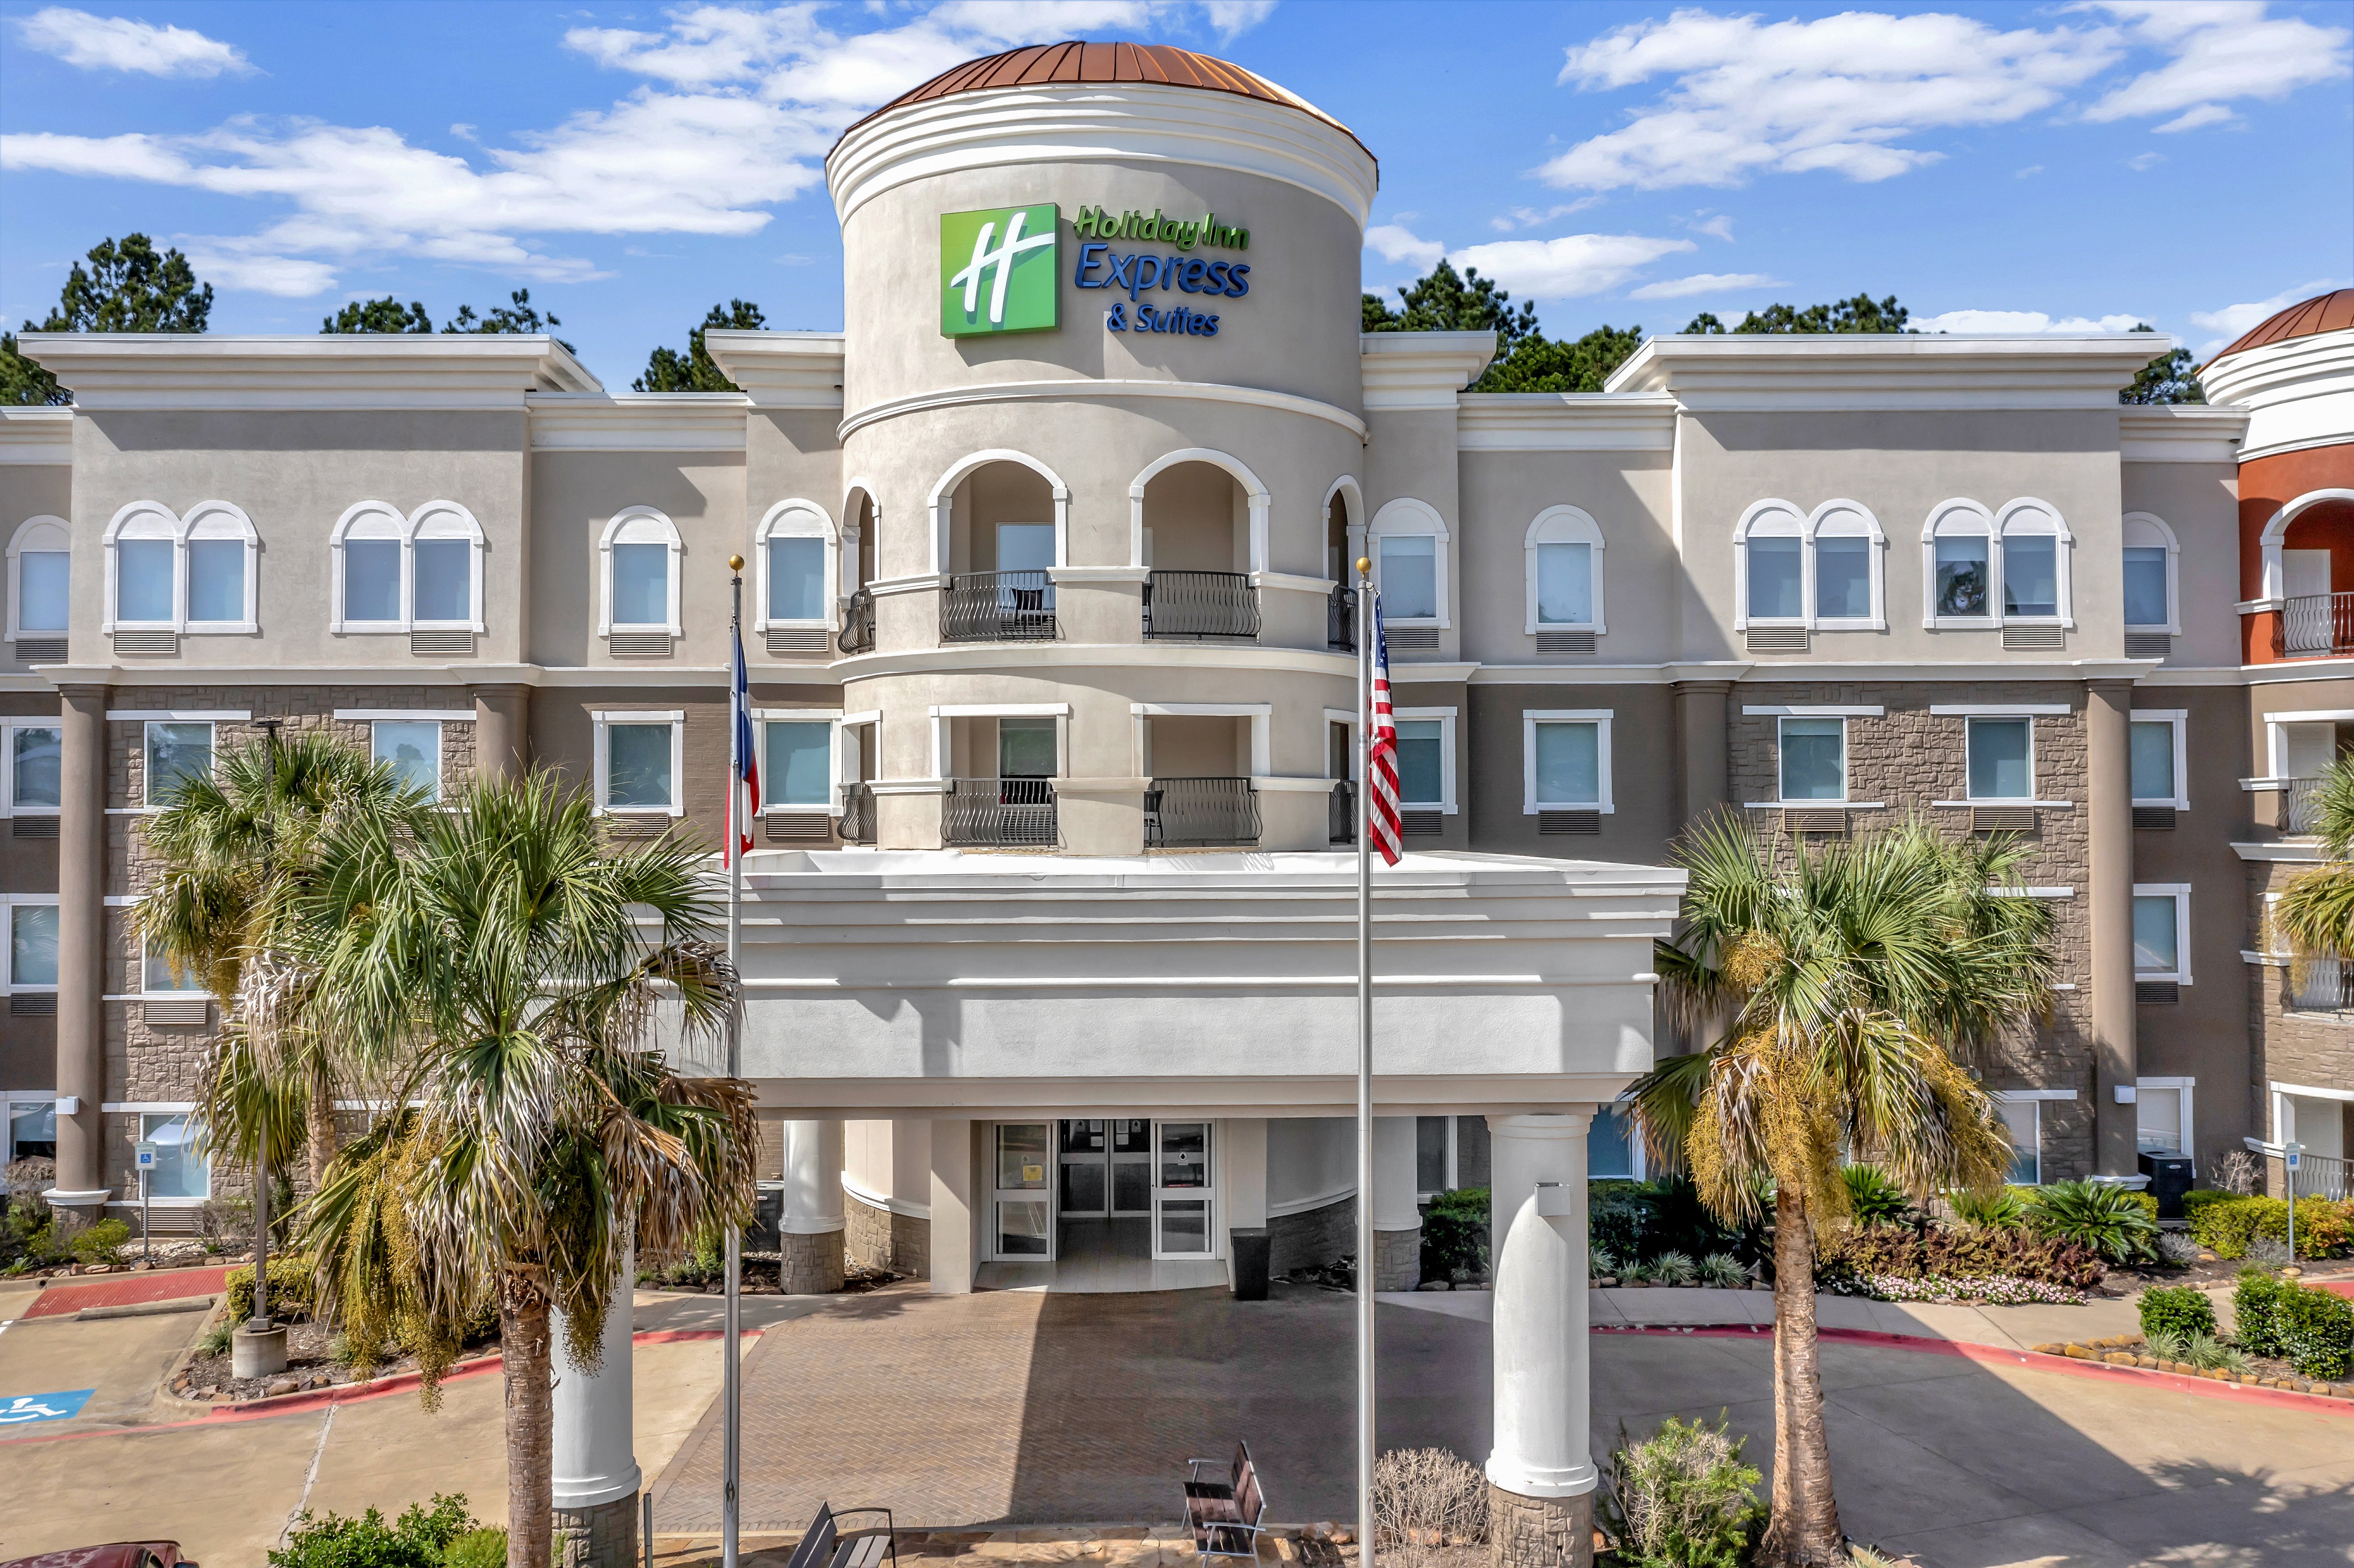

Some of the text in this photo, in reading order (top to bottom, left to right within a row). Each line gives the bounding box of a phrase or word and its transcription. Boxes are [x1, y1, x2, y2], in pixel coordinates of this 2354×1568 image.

[1074, 205, 1250, 251] Holiday Inn
[950, 211, 1056, 323] H
[1074, 243, 1251, 302] Express
[1107, 303, 1220, 336] & Suites
